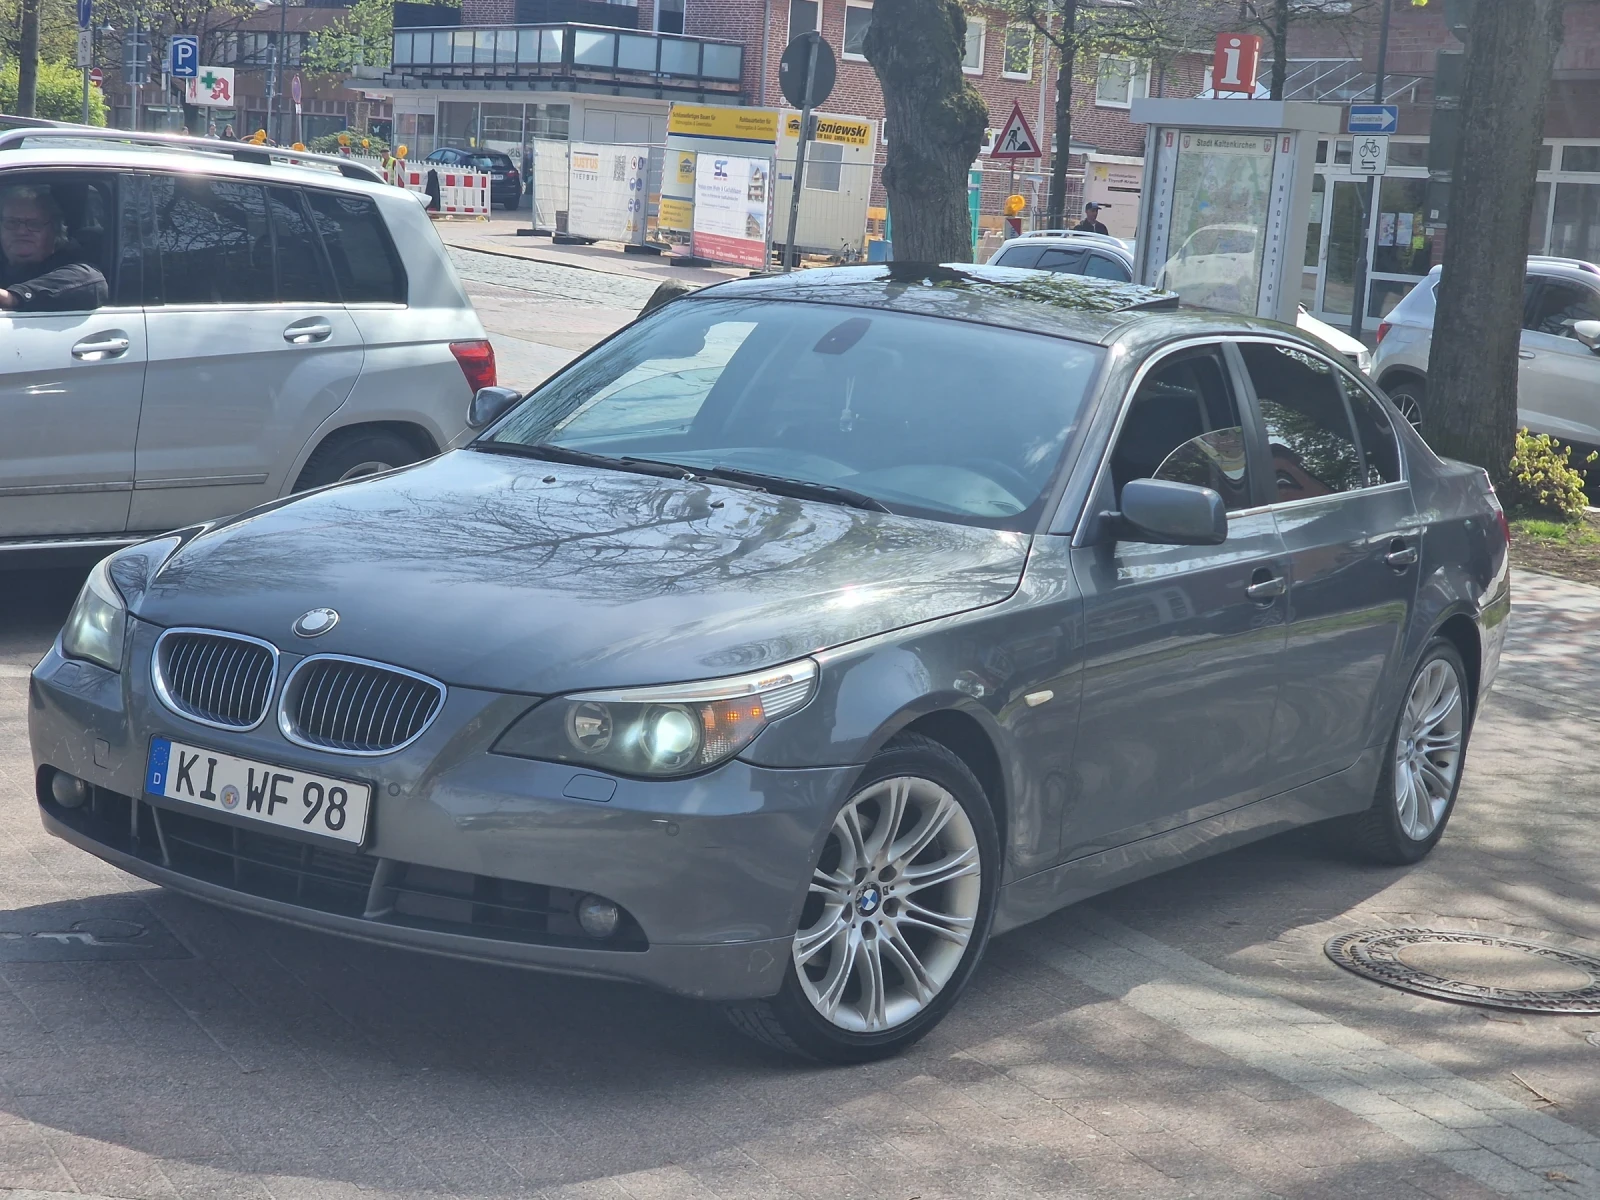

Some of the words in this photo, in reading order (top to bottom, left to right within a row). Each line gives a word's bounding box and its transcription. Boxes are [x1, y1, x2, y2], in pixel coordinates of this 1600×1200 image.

[178, 45, 192, 65] P
[816, 120, 868, 137] isniewski
[1197, 138, 1212, 147] Stadt
[1214, 140, 1256, 149] Kaltenkirchen
[573, 156, 598, 169] JUSTUS
[573, 172, 598, 181] TIEFBAU
[1266, 173, 1285, 302] INFORMATION
[153, 772, 161, 785] D
[176, 750, 218, 801] KI
[246, 768, 294, 816] WF
[302, 782, 348, 830] 98
